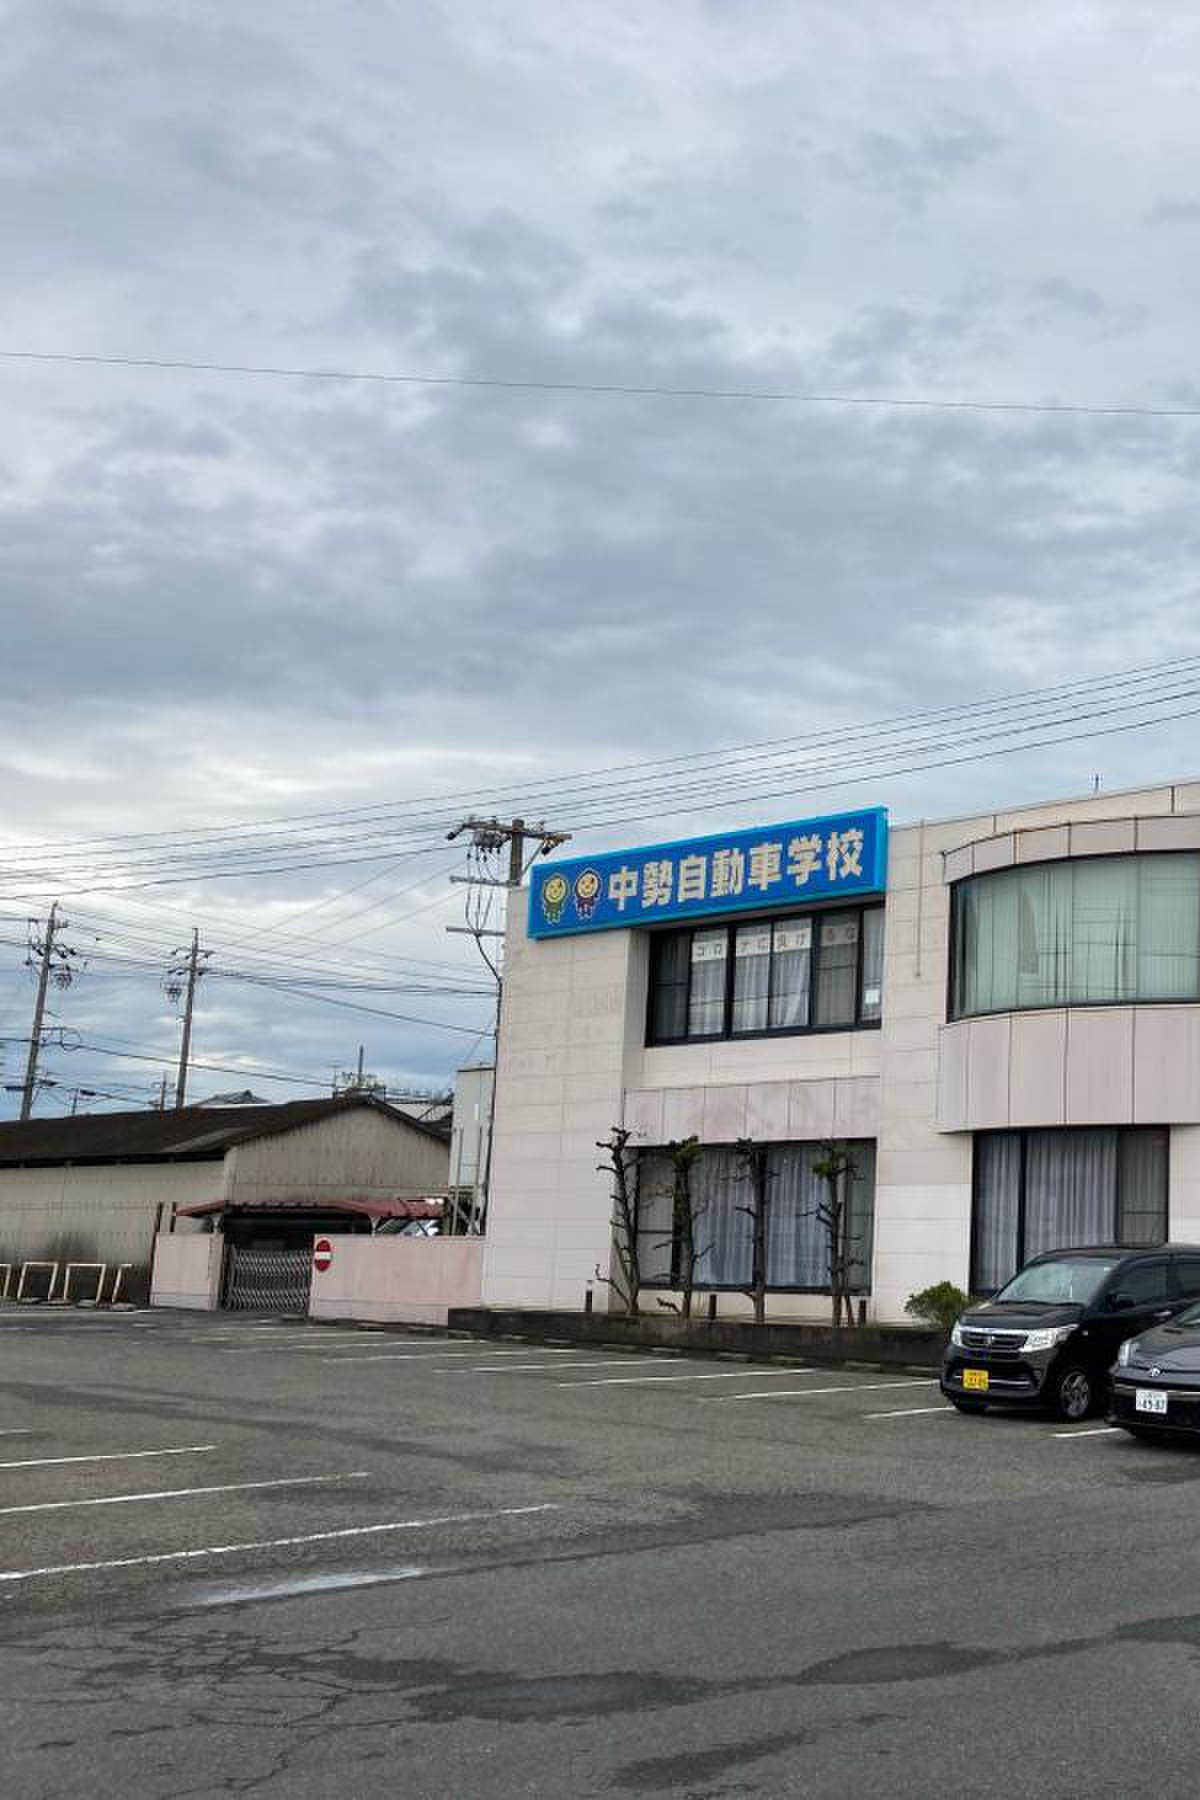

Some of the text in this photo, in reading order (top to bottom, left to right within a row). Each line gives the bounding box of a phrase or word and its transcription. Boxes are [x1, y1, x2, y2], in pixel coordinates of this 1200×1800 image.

[608, 828, 864, 911] 中勢自動車学校
